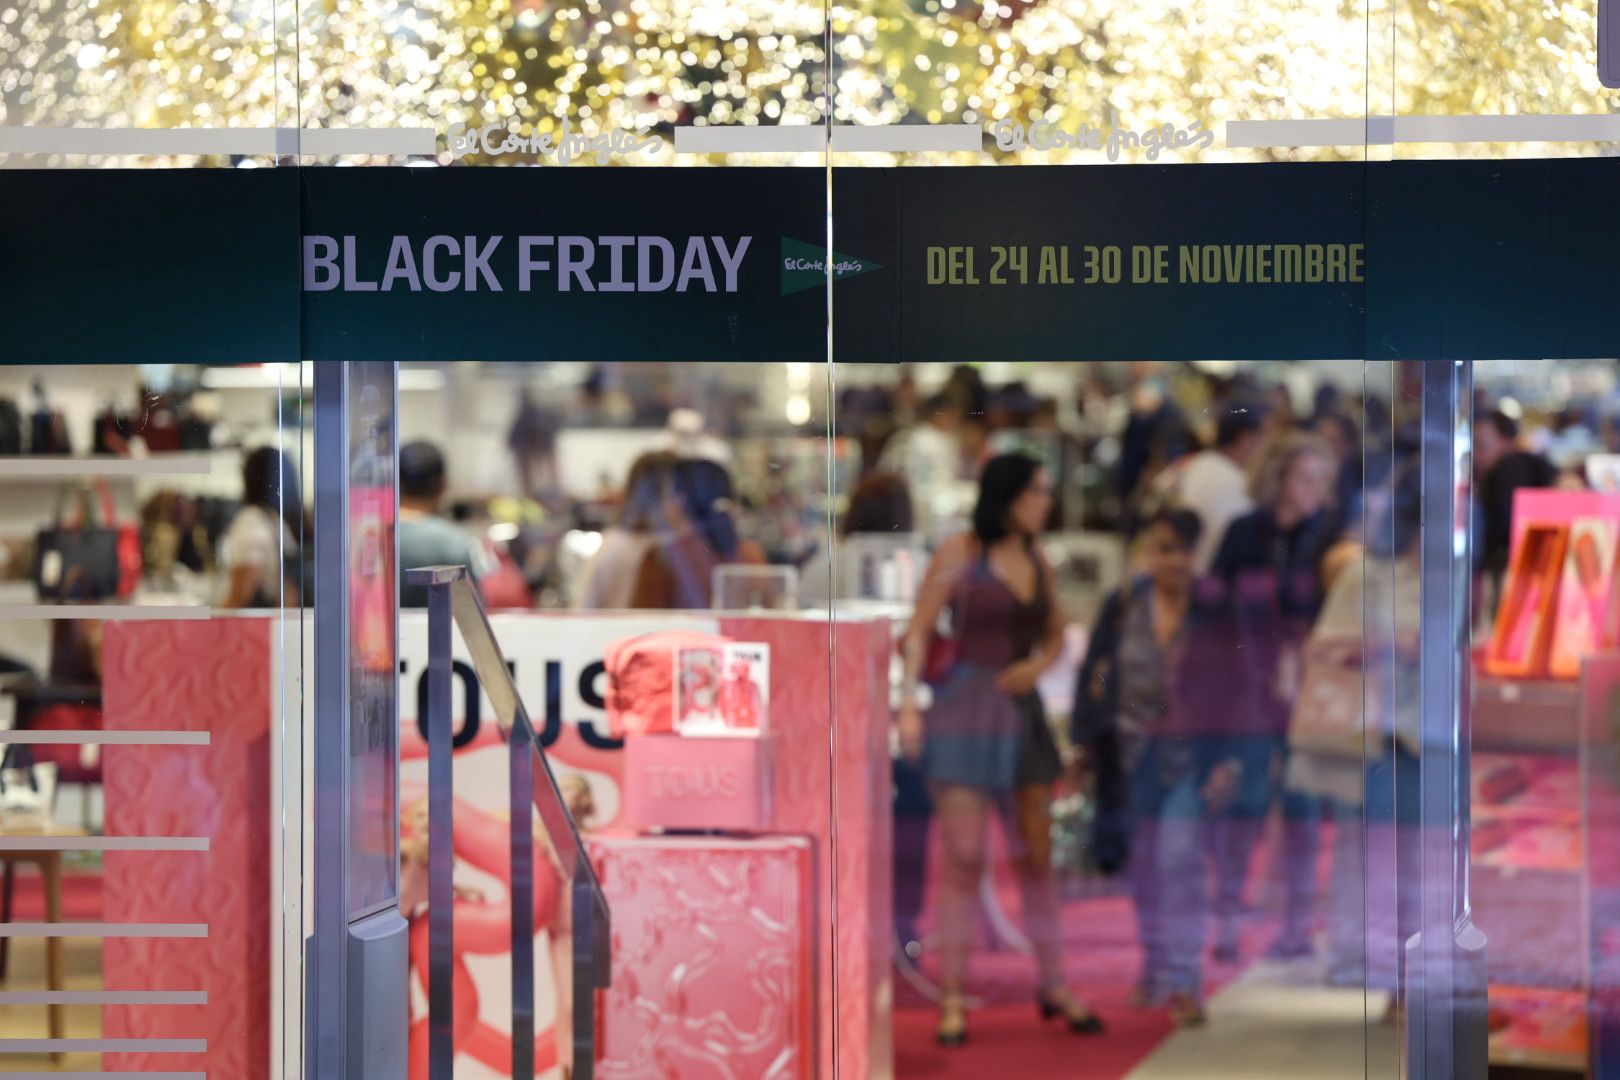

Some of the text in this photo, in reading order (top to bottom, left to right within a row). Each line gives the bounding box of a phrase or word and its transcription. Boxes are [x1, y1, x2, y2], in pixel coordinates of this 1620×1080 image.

[449, 121, 480, 157] El
[480, 123, 553, 155] Corte
[994, 118, 1027, 152] El
[1027, 119, 1102, 151] Corte
[303, 234, 752, 292] BLACK FRIDAY
[784, 257, 797, 270] El
[796, 258, 823, 270] Corte
[926, 243, 1364, 285] DEL 24 AL 30 DE NOVIEMBRE
[400, 660, 624, 751] OUS
[646, 763, 741, 799] TOUS
